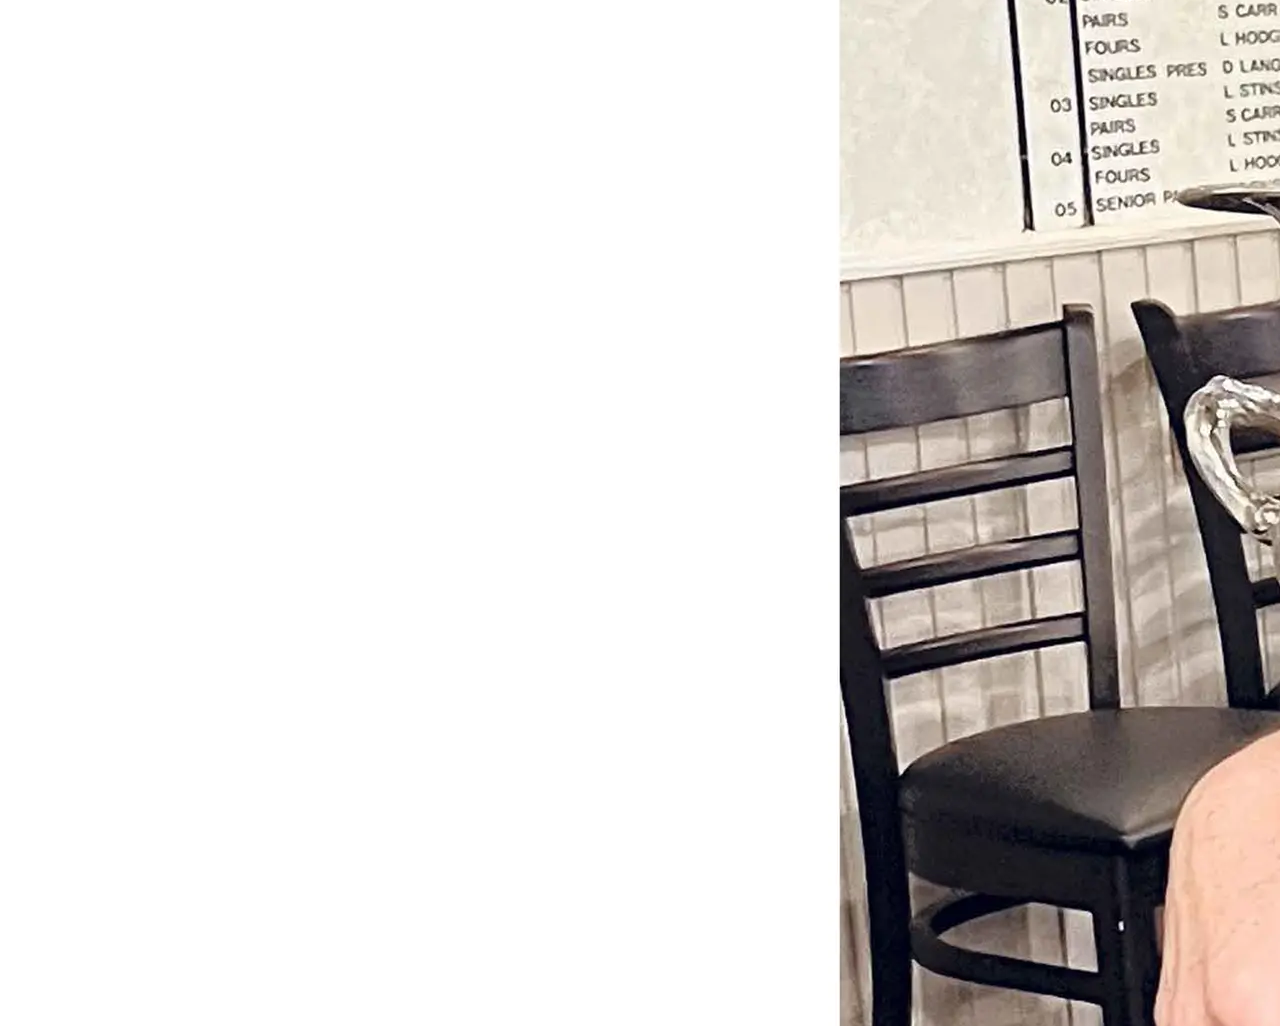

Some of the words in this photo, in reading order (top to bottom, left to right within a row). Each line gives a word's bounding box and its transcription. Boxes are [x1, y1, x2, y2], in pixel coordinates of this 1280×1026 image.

[1083, 13, 1128, 27] PAIRS
[1085, 39, 1141, 55] FOURS
[1088, 65, 1156, 83] SINGLES
[1167, 62, 1207, 77] PRES
[1240, 58, 1280, 73] LANG
[1051, 98, 1071, 112] 03
[1089, 92, 1157, 111] SINGLES
[1091, 118, 1136, 135] PAIRS
[1091, 139, 1160, 160] SINGLES
[1051, 152, 1072, 166] 04
[1095, 168, 1150, 183] FOURS
[1055, 202, 1077, 217] 05
[1097, 192, 1156, 212] SENIOR
